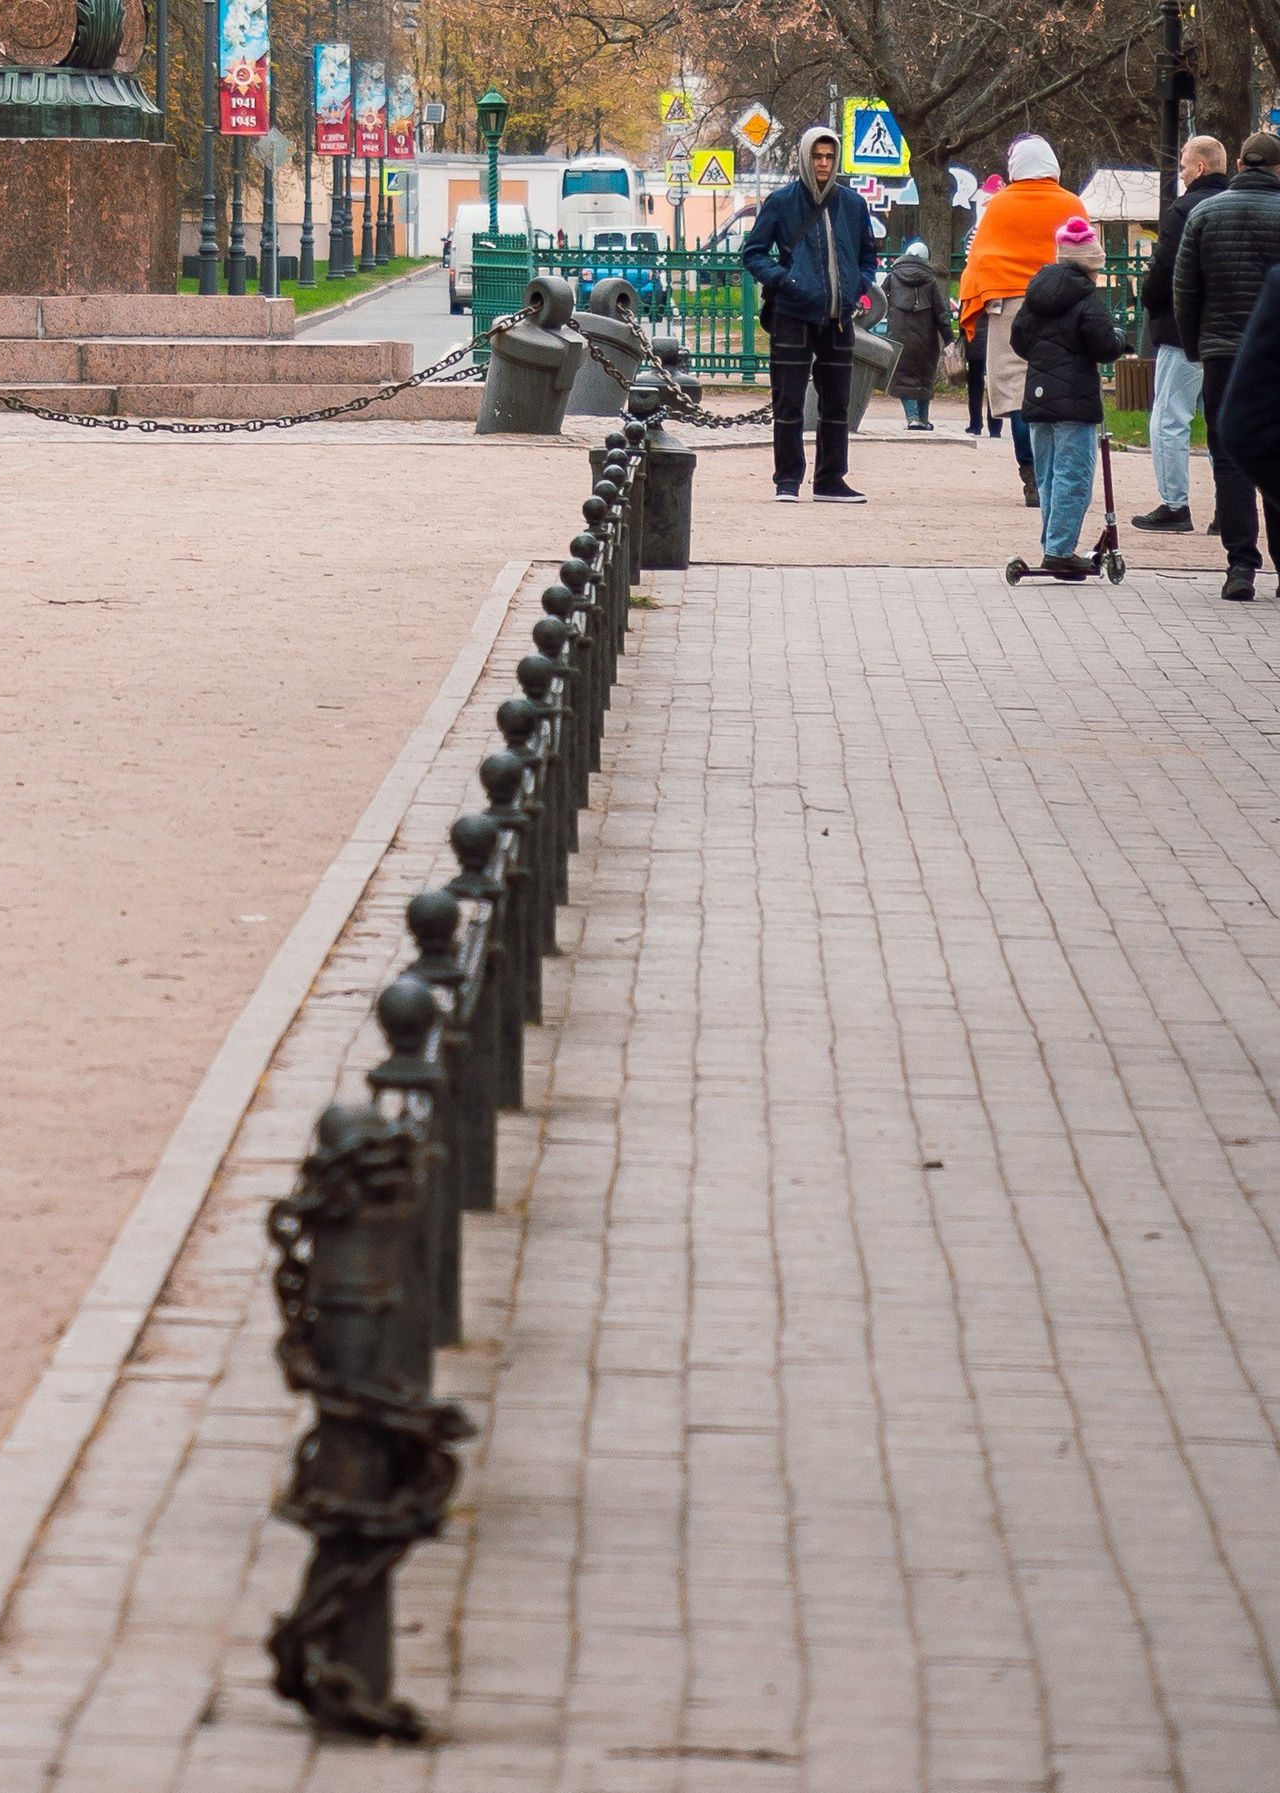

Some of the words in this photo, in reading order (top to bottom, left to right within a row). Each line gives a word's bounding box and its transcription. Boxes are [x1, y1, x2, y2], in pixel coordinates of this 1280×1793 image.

[230, 96, 256, 109] 1941
[230, 115, 257, 128] 1945
[397, 135, 406, 147] 9
